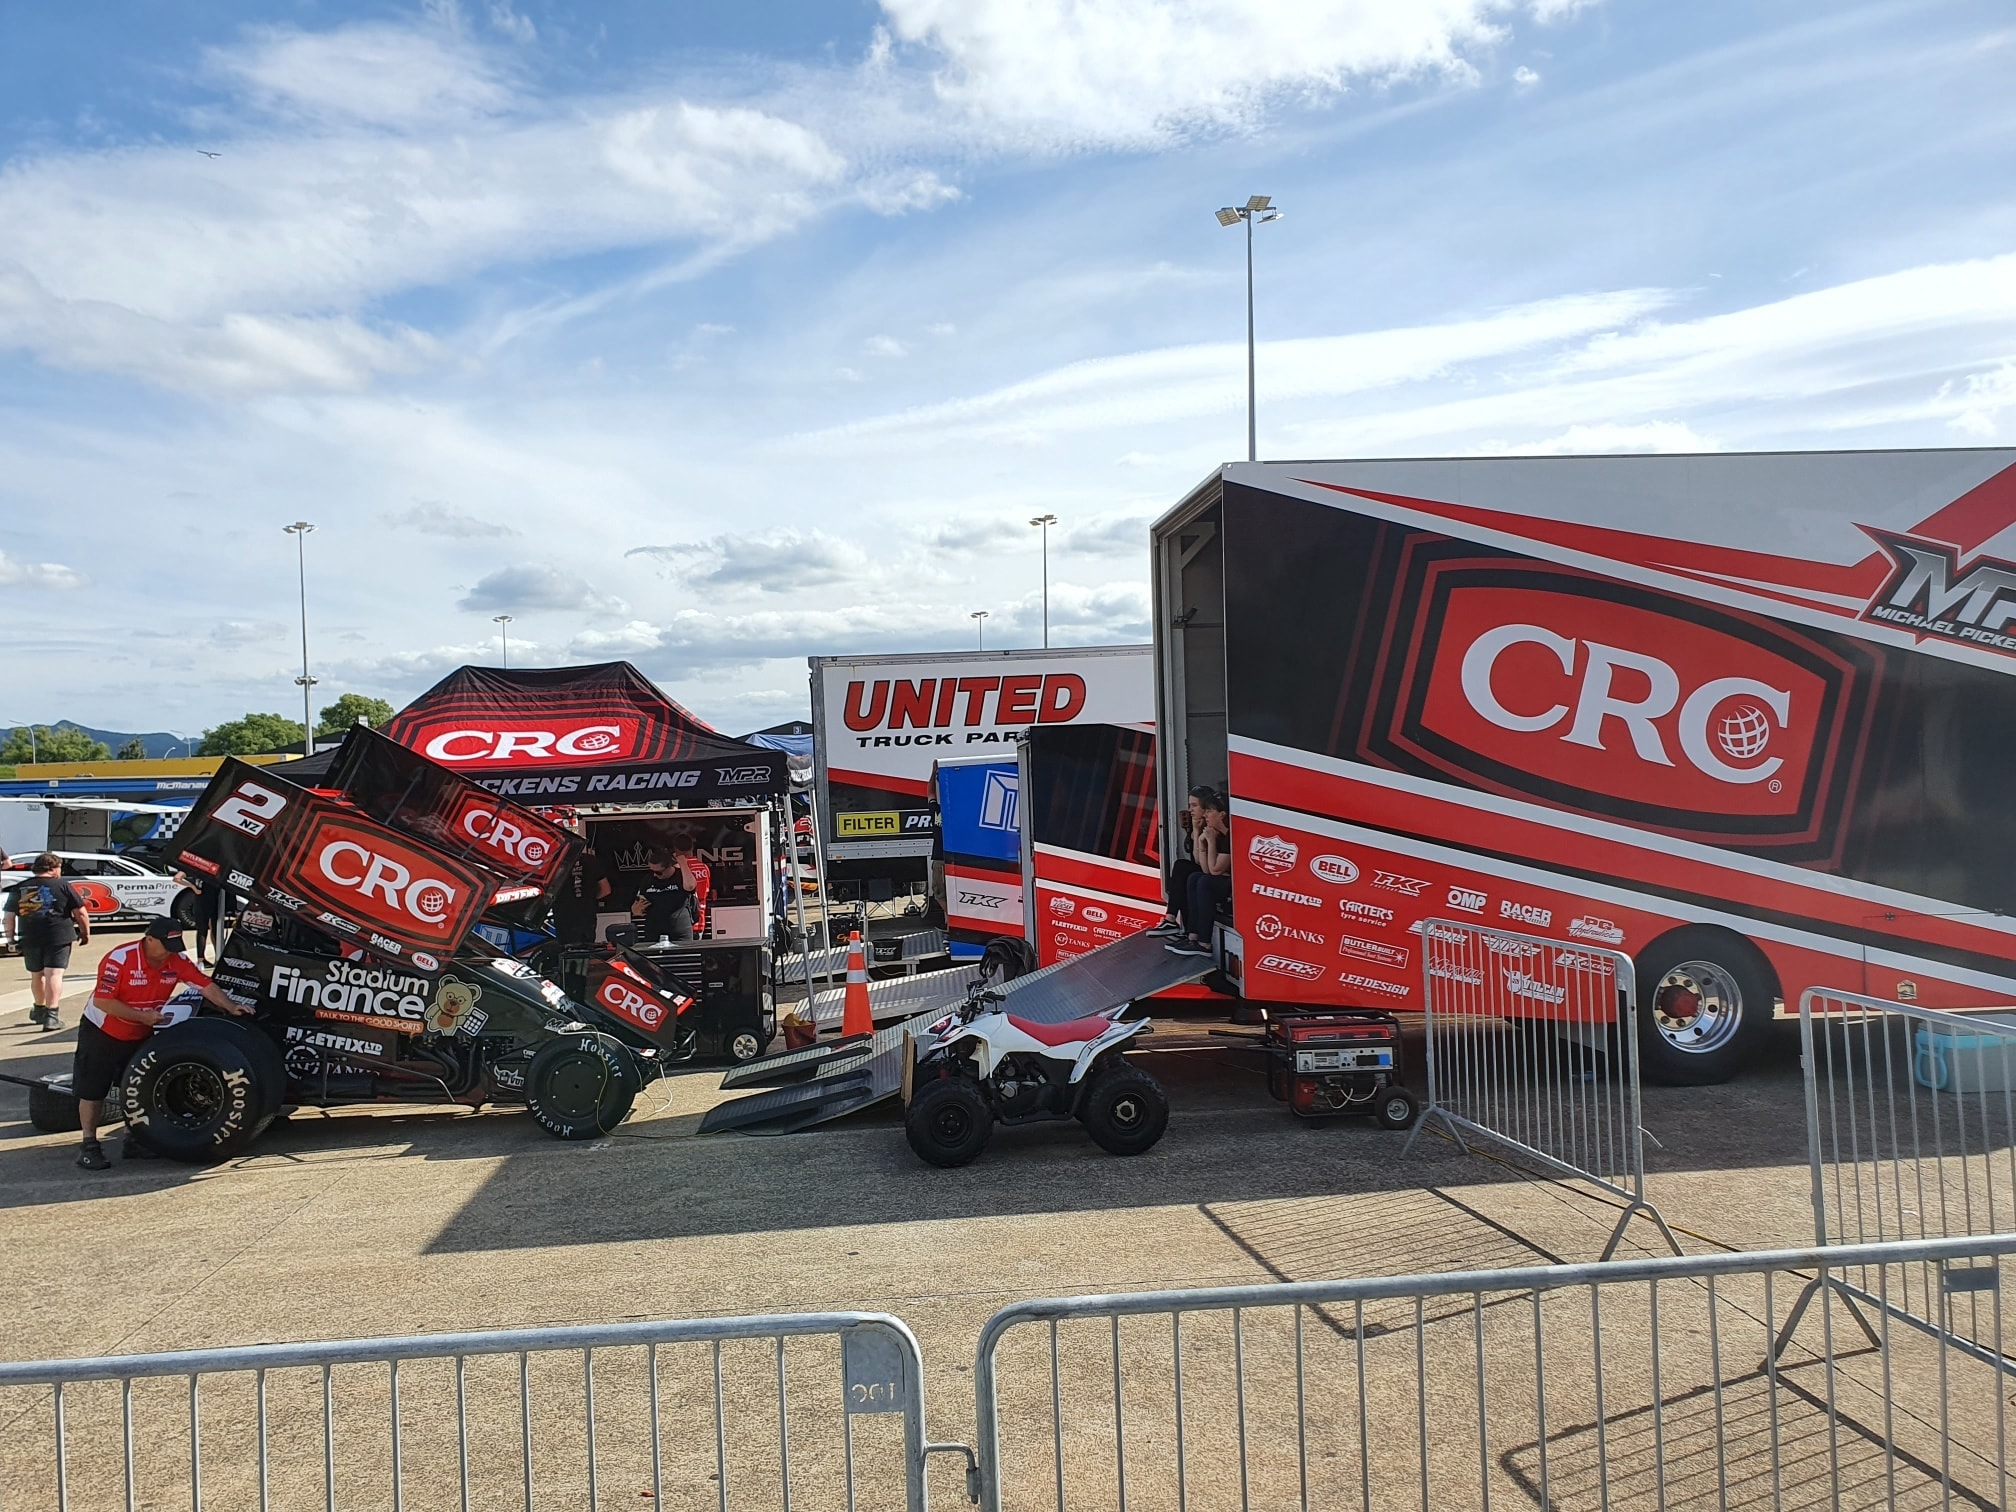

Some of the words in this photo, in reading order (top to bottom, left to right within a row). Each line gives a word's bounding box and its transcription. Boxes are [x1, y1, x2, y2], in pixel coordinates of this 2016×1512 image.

[1871, 606, 1956, 635] MICHAEL
[843, 673, 1087, 732] UNITED
[1461, 624, 1791, 784] CRC
[426, 725, 621, 761] CRC
[856, 733, 954, 748] TRUCK
[586, 770, 702, 792] RACING
[211, 782, 287, 836] 2
[239, 818, 260, 832] NZ
[843, 816, 895, 831] FILTER
[464, 809, 550, 866] CRC
[1256, 846, 1294, 860] LUCAS
[1318, 861, 1351, 877] BELL
[116, 882, 179, 891] PermaPine
[229, 873, 253, 888] OMP
[319, 840, 457, 923] CRC
[1447, 890, 1487, 910] OMP
[1500, 900, 1553, 922] RACER
[1086, 909, 1104, 919] BELL
[1341, 912, 1357, 922] tyre
[1358, 916, 1387, 928] service
[1069, 939, 1091, 948] TANKS
[1260, 920, 1279, 934] KP
[1282, 926, 1326, 945] TANKS
[415, 955, 434, 968] BELL
[325, 960, 430, 997] Stadium
[269, 965, 426, 1020] Finance
[604, 983, 663, 1025] CRC
[319, 1011, 339, 1021] TALK
[339, 1014, 351, 1022] TO
[350, 1016, 365, 1024] THE
[365, 1017, 393, 1028] GOOD
[393, 1020, 422, 1032] SPORTS
[364, 1042, 383, 1052] LTD
[578, 1038, 623, 1078] Hoosier
[123, 1050, 157, 1127] Hoosier
[213, 1068, 251, 1145] Hoosier
[529, 1098, 574, 1137] Hoosier
